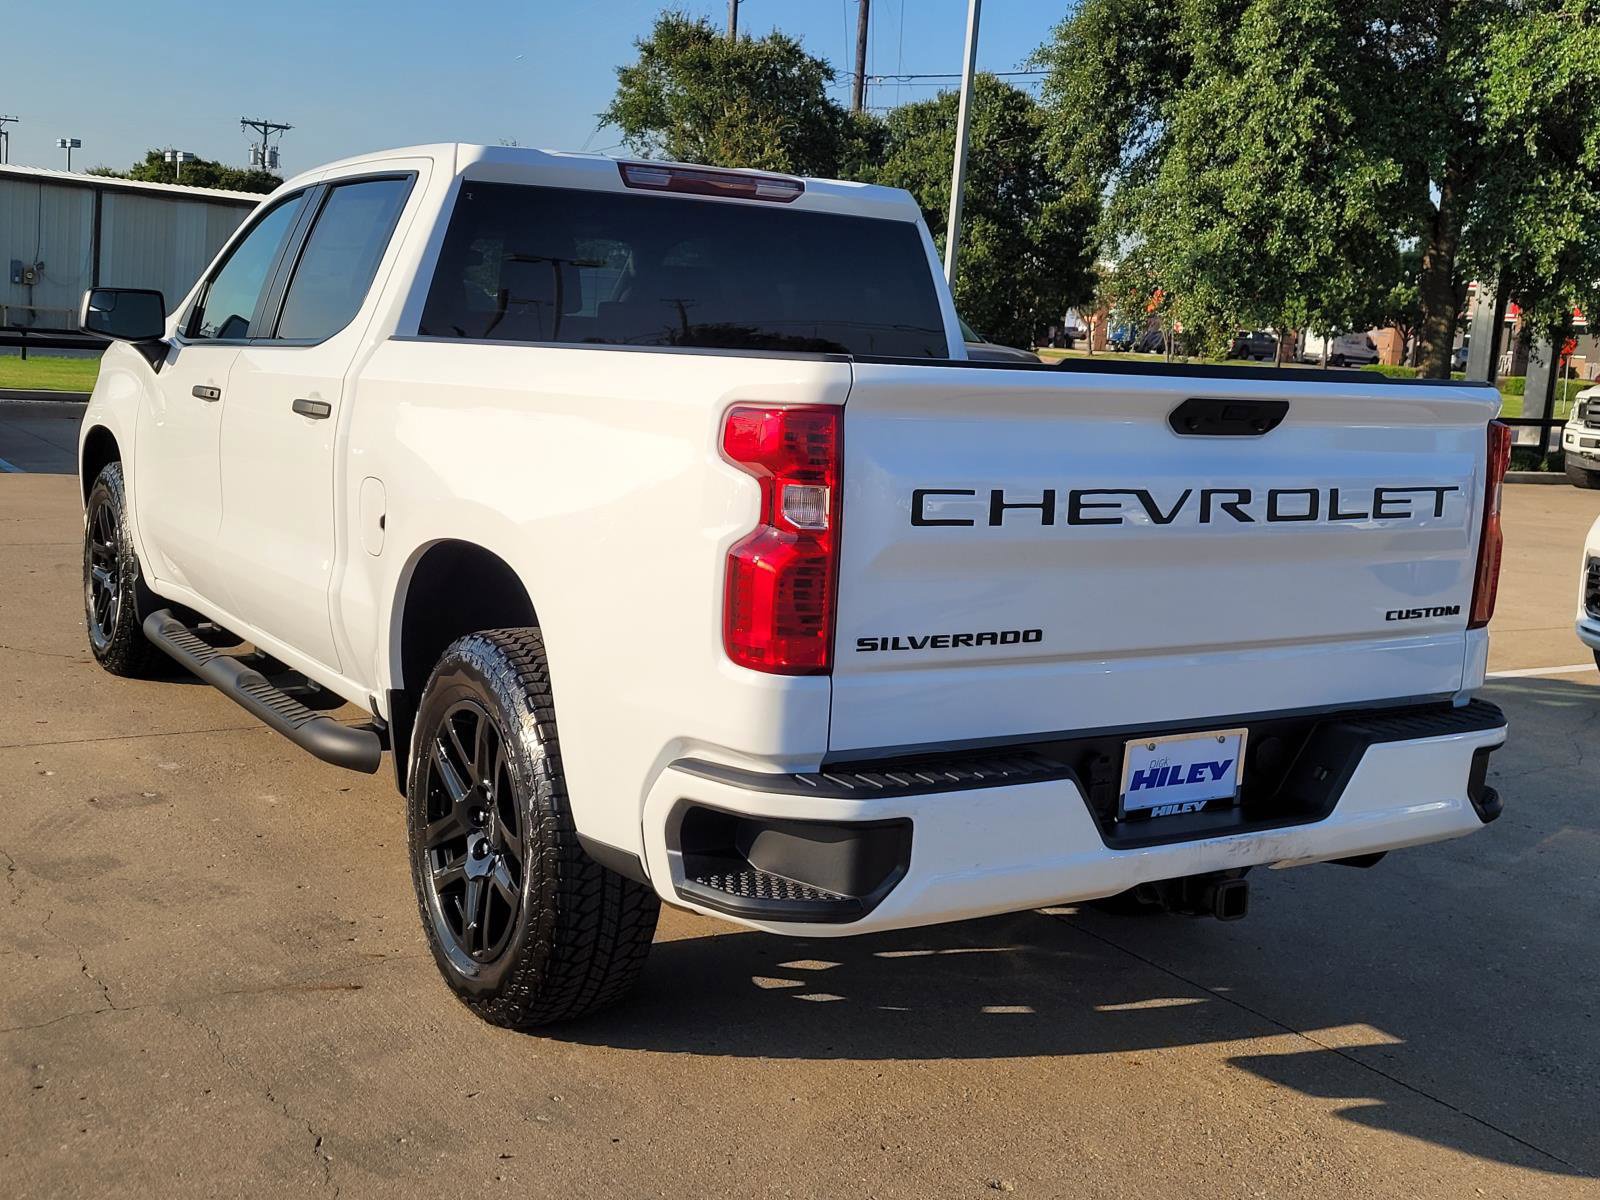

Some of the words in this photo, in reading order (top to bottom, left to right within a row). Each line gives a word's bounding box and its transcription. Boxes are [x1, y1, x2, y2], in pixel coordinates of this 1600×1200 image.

[911, 487, 1459, 527] CHEVROLET
[1385, 605, 1461, 621] CUSTOM
[855, 629, 1043, 652] SILVERADO
[1129, 759, 1234, 791] HILEY
[1151, 800, 1207, 817] HILEY
